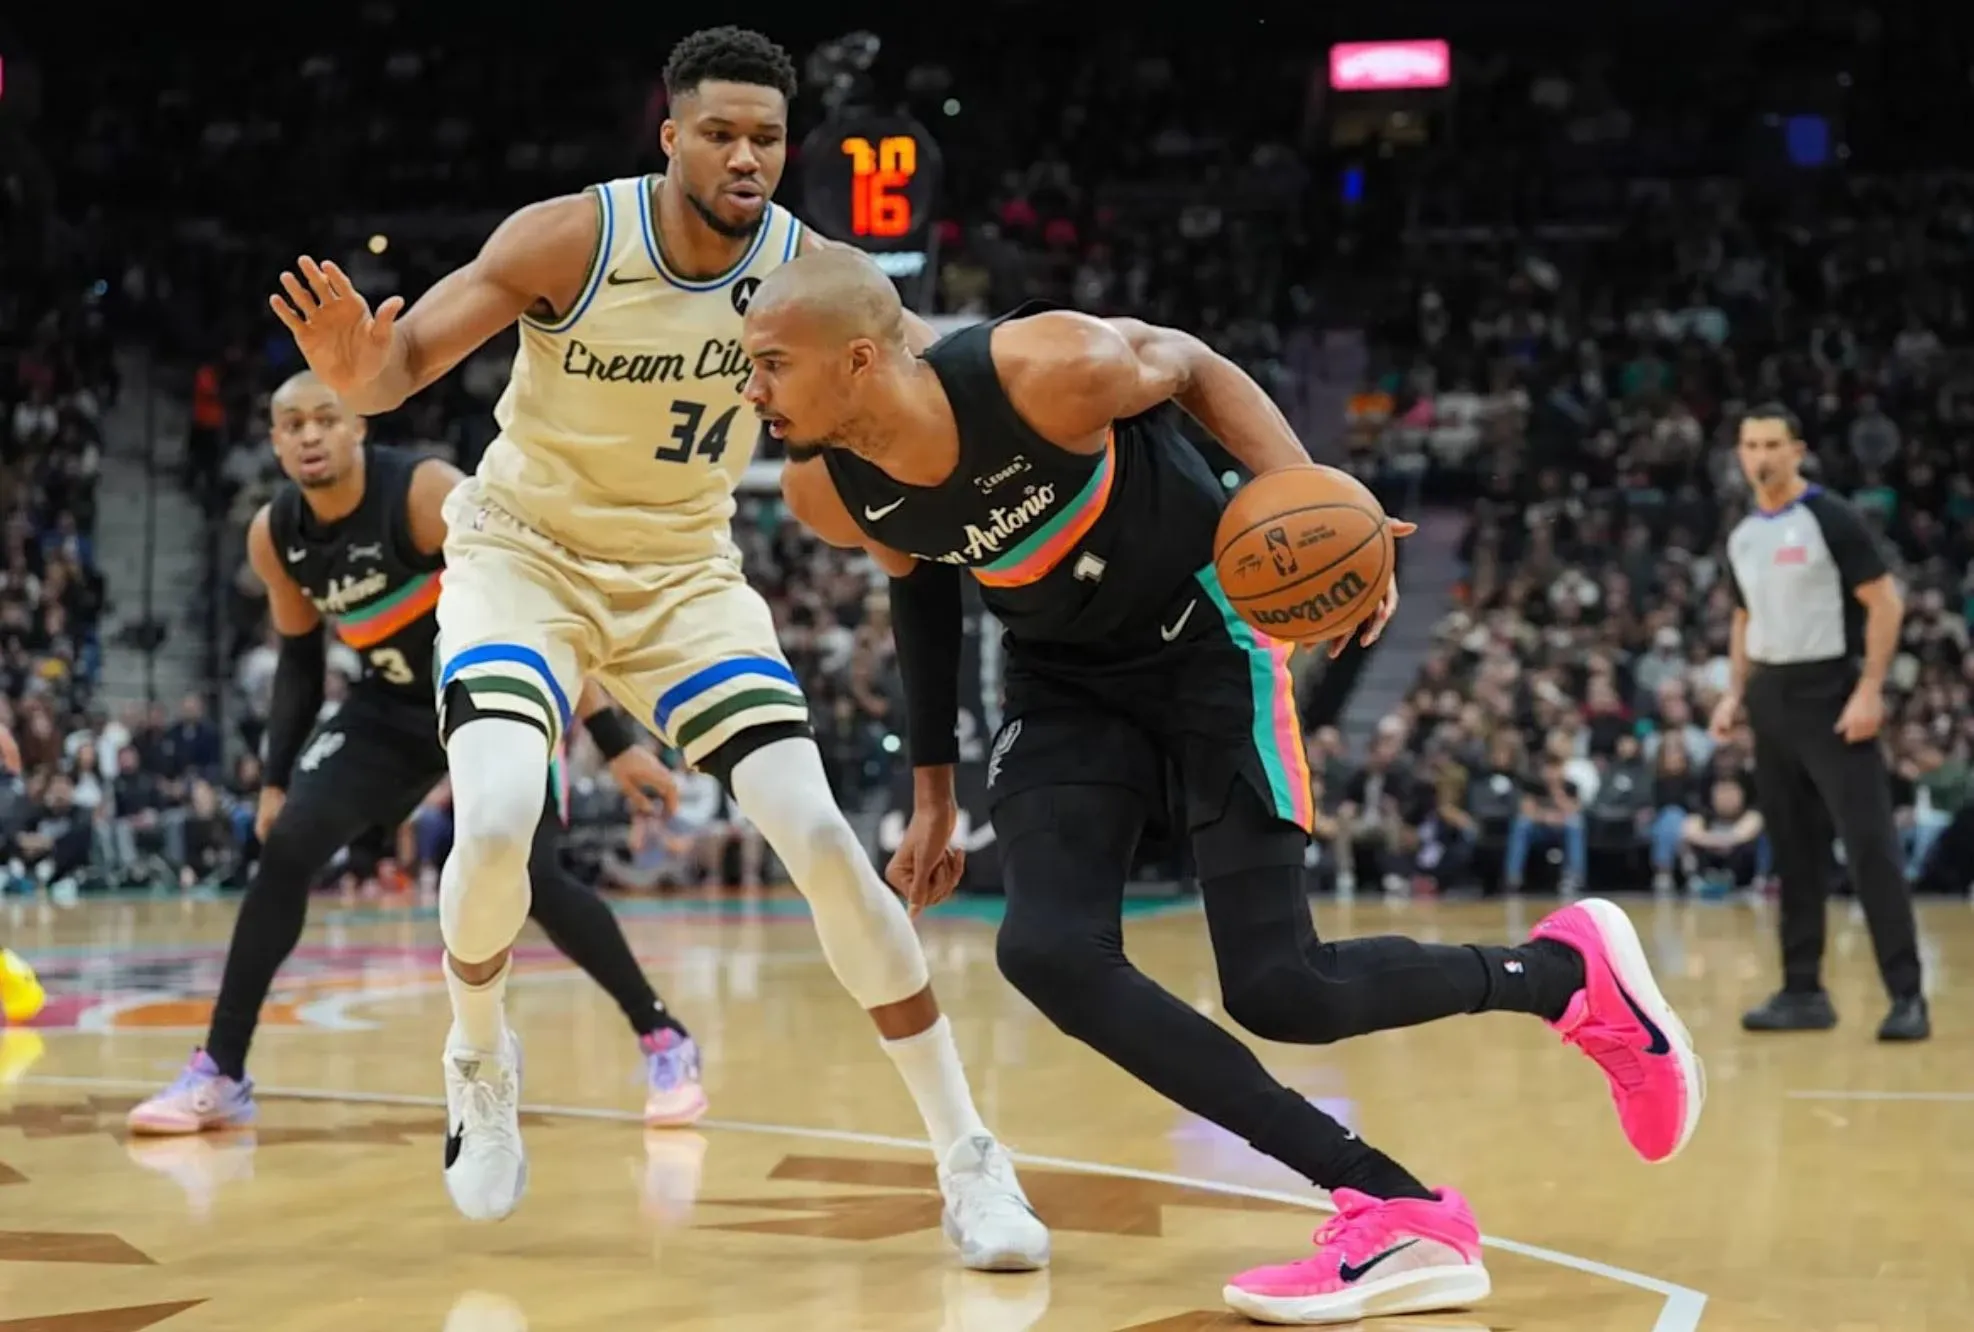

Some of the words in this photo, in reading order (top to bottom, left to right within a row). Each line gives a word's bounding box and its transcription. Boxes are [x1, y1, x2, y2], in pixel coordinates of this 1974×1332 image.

[563, 339, 684, 383] Cream
[655, 399, 742, 464] 34
[962, 482, 1056, 560] Antonio
[1249, 570, 1367, 625] Wilson
[370, 648, 415, 685] 3
